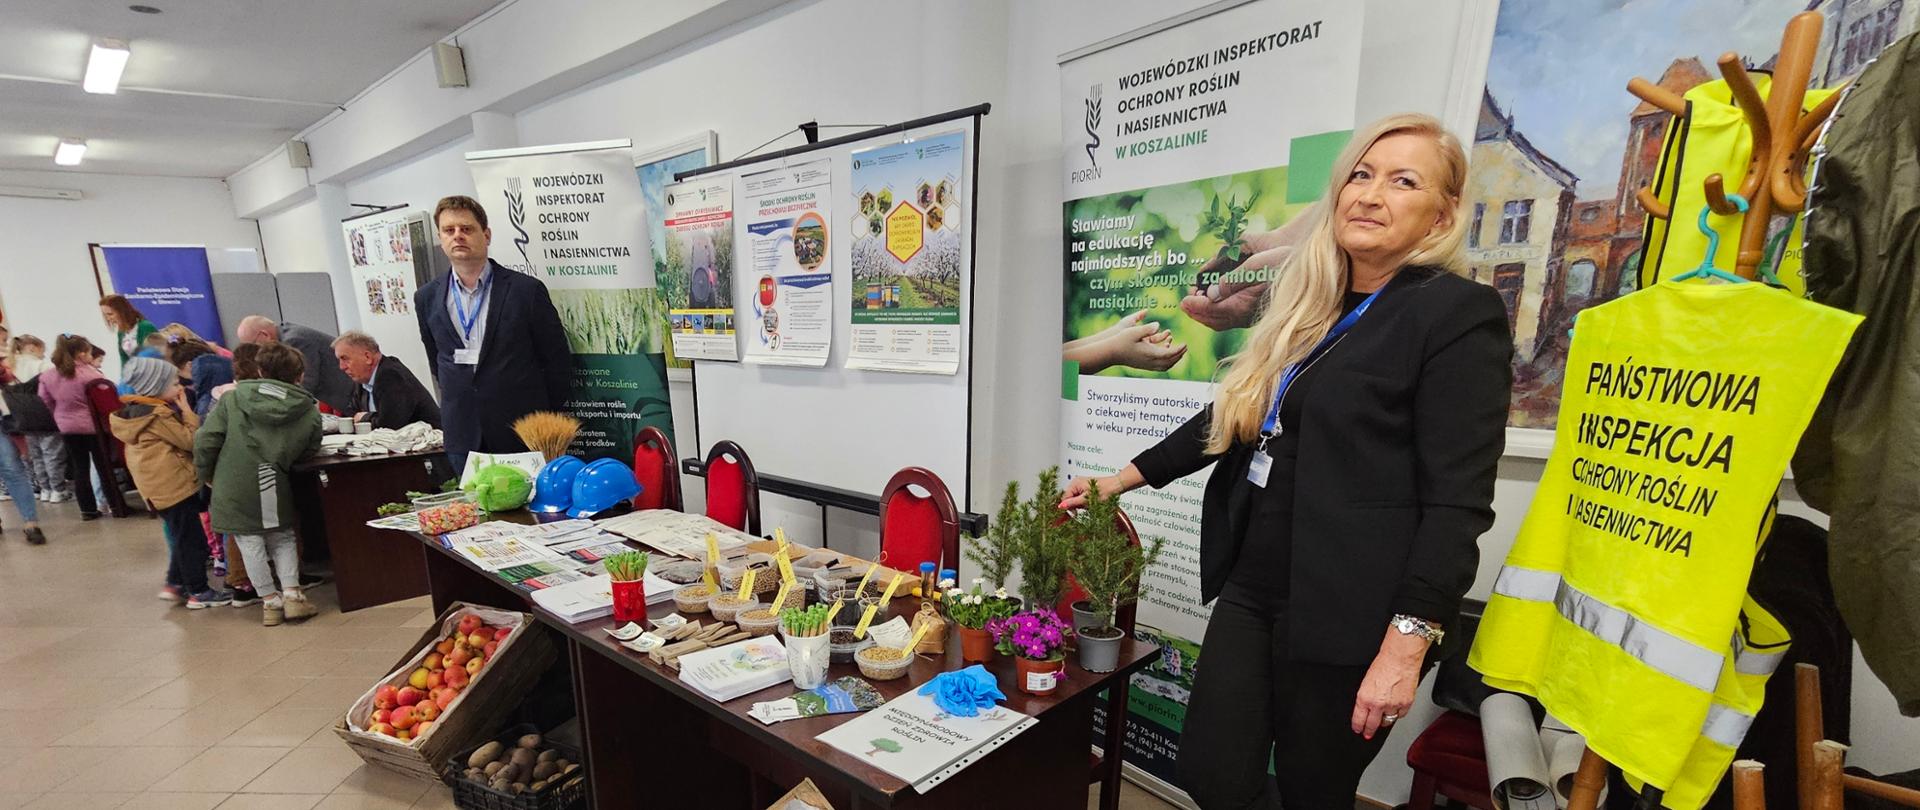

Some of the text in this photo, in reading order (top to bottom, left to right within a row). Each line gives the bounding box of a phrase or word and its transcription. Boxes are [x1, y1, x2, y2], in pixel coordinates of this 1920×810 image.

[1118, 20, 1322, 91] WOJEWÓDZKI INSPEKTORAT
[1117, 70, 1240, 114] OCHRONY ROŚLIN
[1116, 99, 1227, 137] I NASIENNICTWA
[1115, 129, 1208, 160] W KOSZALINIE
[532, 172, 604, 188] WOJEWÓDZKI
[1071, 166, 1102, 184] PIORIN
[535, 192, 605, 206] INSPEKTORAT
[538, 211, 590, 224] OCHRONY
[1071, 213, 1136, 235] Stawiamy
[541, 228, 579, 242] ROŚLIN
[1071, 231, 1154, 253] na edukację
[544, 246, 631, 259] I NASIENNICTWA
[1071, 249, 1162, 274] najmłodszych
[1167, 250, 1187, 266] bo
[546, 264, 619, 276] W KOSZALINIE
[1089, 276, 1123, 293] czym
[1128, 270, 1198, 290] skorupka
[1202, 271, 1220, 285] za
[1089, 293, 1158, 312] nasiąknie
[596, 378, 639, 389] Koszalinie
[1586, 356, 1761, 415] PAŃSTWOWA
[571, 399, 606, 408] zdrowiem
[607, 400, 626, 408] roślin
[1087, 389, 1150, 406] Stworzyliśmy
[1152, 394, 1200, 410] autorskie
[576, 409, 608, 420] eksportu
[614, 410, 641, 420] importu
[1086, 406, 1188, 425] o ciekawej tematyce
[1086, 421, 1170, 439] w wieku przedszk
[585, 439, 616, 447] środków
[1068, 441, 1086, 454] Nasze
[1577, 412, 1734, 474] INSPEKCJA
[1075, 459, 1117, 474] Wzbudzenie
[1181, 478, 1205, 490] dzieci
[1150, 490, 1178, 503] między
[1636, 474, 1718, 518] ROŚLIN
[1134, 503, 1145, 512] na
[1146, 505, 1188, 522] zagrożenia
[1155, 587, 1166, 596] na
[1150, 596, 1181, 613] ochrony
[883, 713, 956, 747] DZIEŃ ZDROWIA
[891, 726, 926, 745] ROŚLIN
